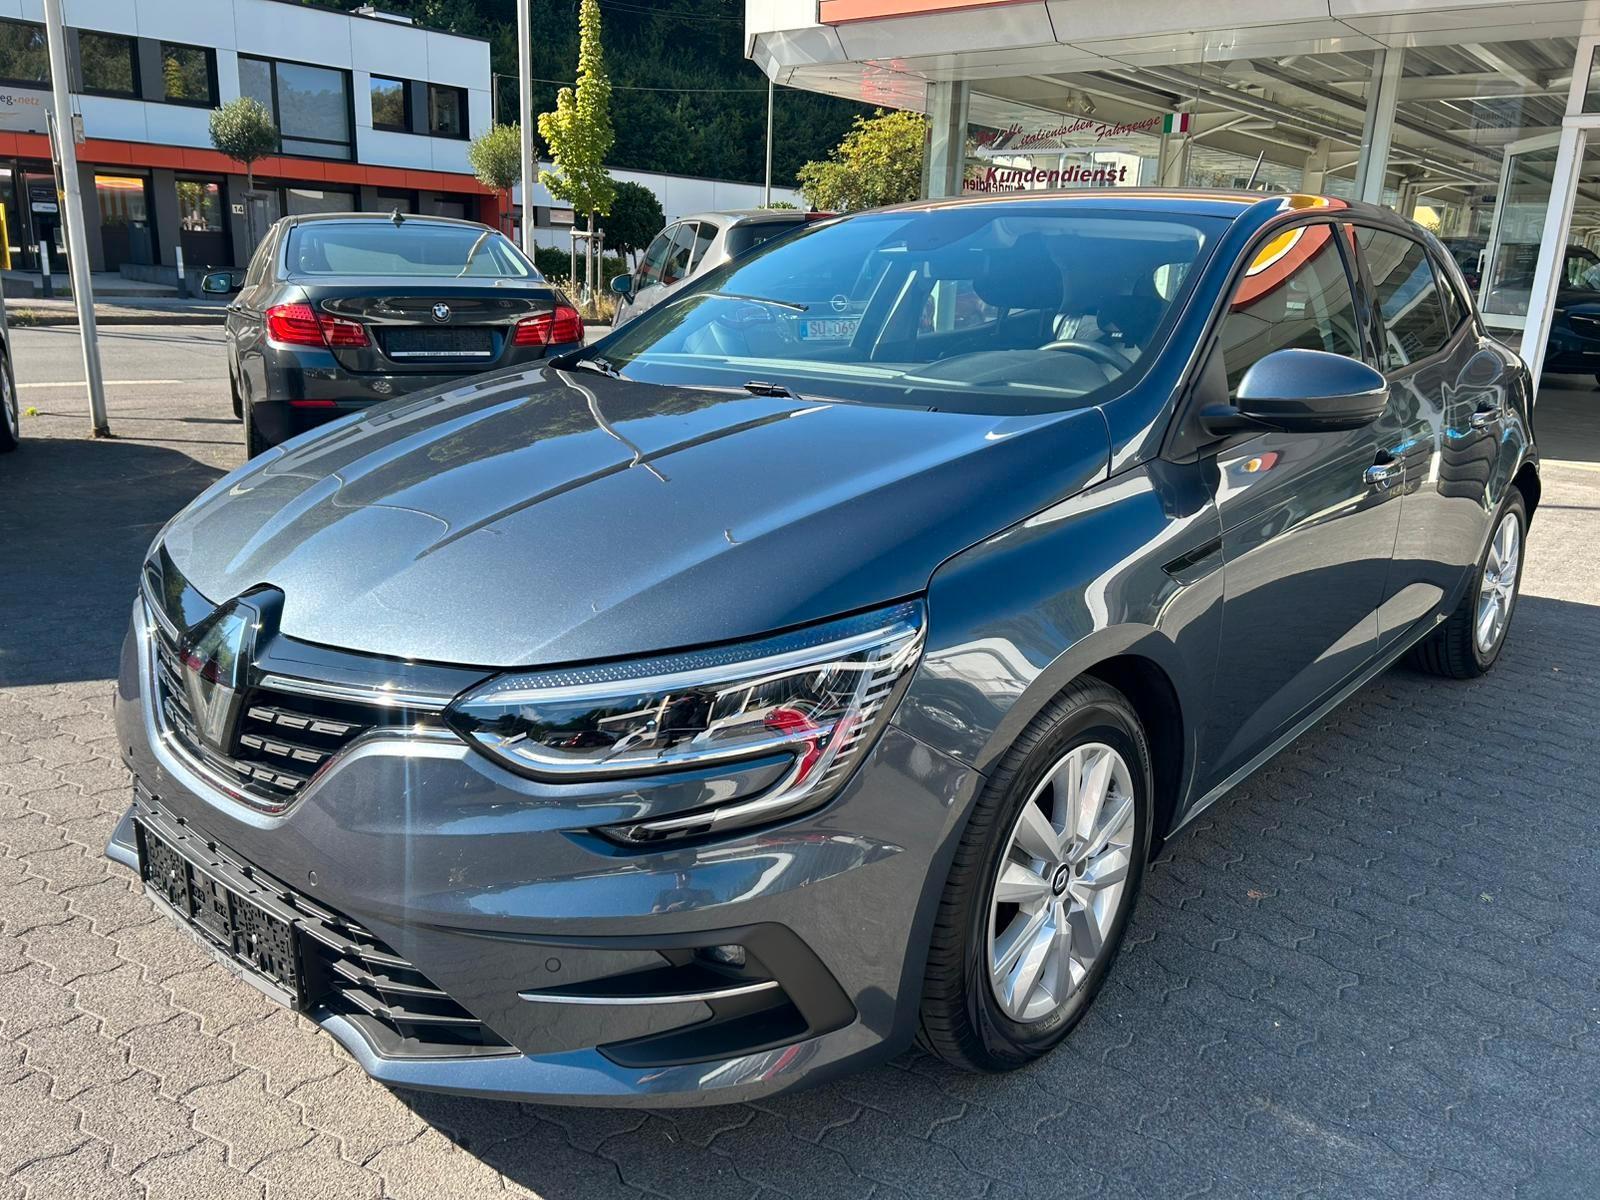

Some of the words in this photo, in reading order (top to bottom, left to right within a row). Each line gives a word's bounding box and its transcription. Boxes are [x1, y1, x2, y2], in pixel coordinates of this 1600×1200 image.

[1021, 118, 1094, 145] italienischen
[1095, 116, 1161, 142] Fahrzeuge
[985, 165, 1127, 183] Kundendienst
[809, 321, 826, 335] SU
